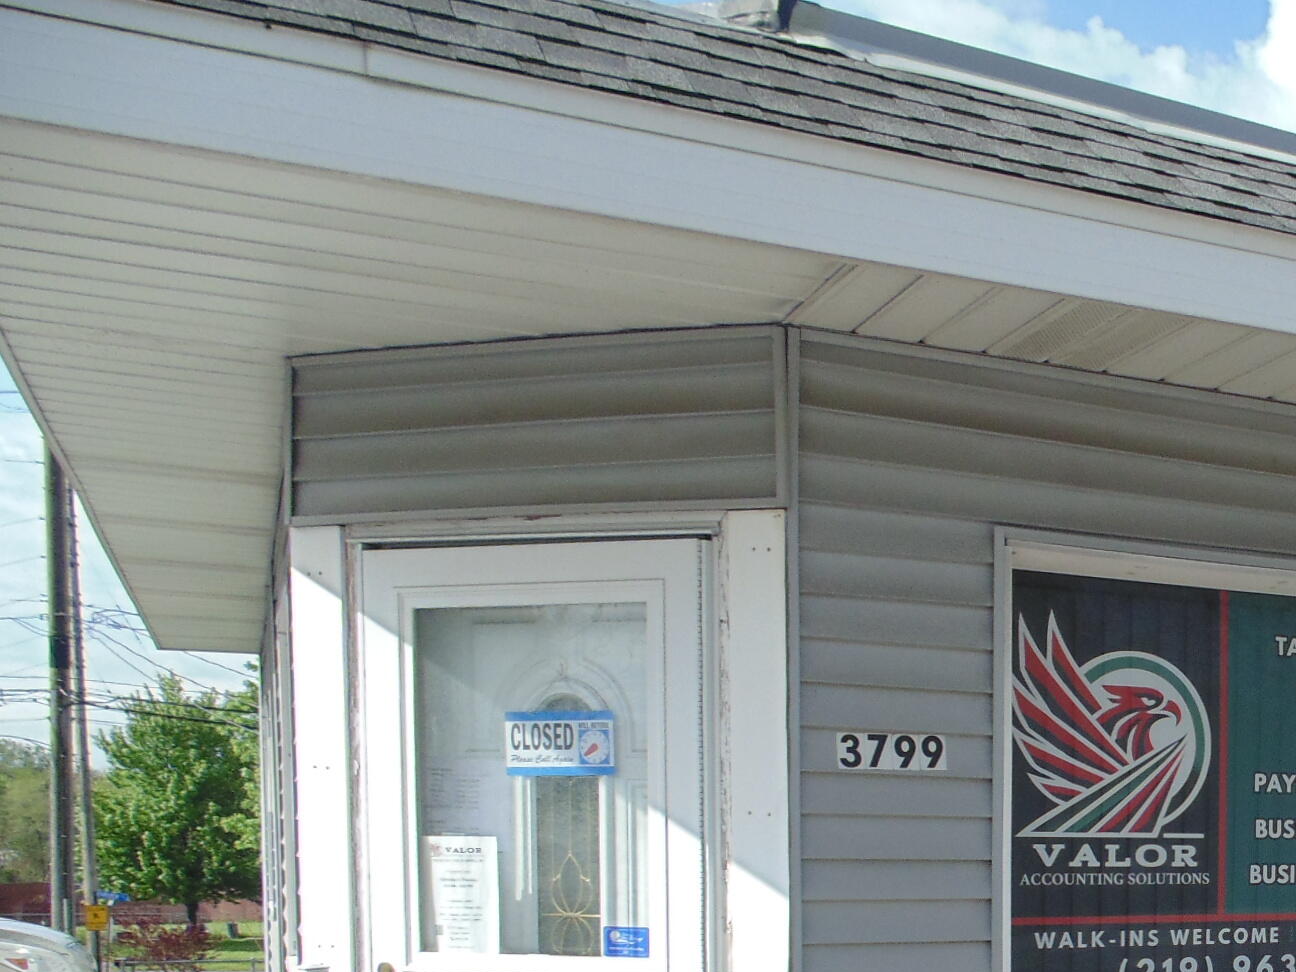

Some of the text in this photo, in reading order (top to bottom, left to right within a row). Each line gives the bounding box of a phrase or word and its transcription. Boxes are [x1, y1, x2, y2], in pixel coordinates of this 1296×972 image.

[511, 722, 574, 750] CLOSED
[839, 733, 943, 769] 3799
[1032, 843, 1198, 868] VALOR
[1019, 872, 1211, 887] ACCOUNTING SOLUTIONS
[1034, 929, 1160, 950] WALK-INS
[1170, 926, 1280, 946] WELCOME
